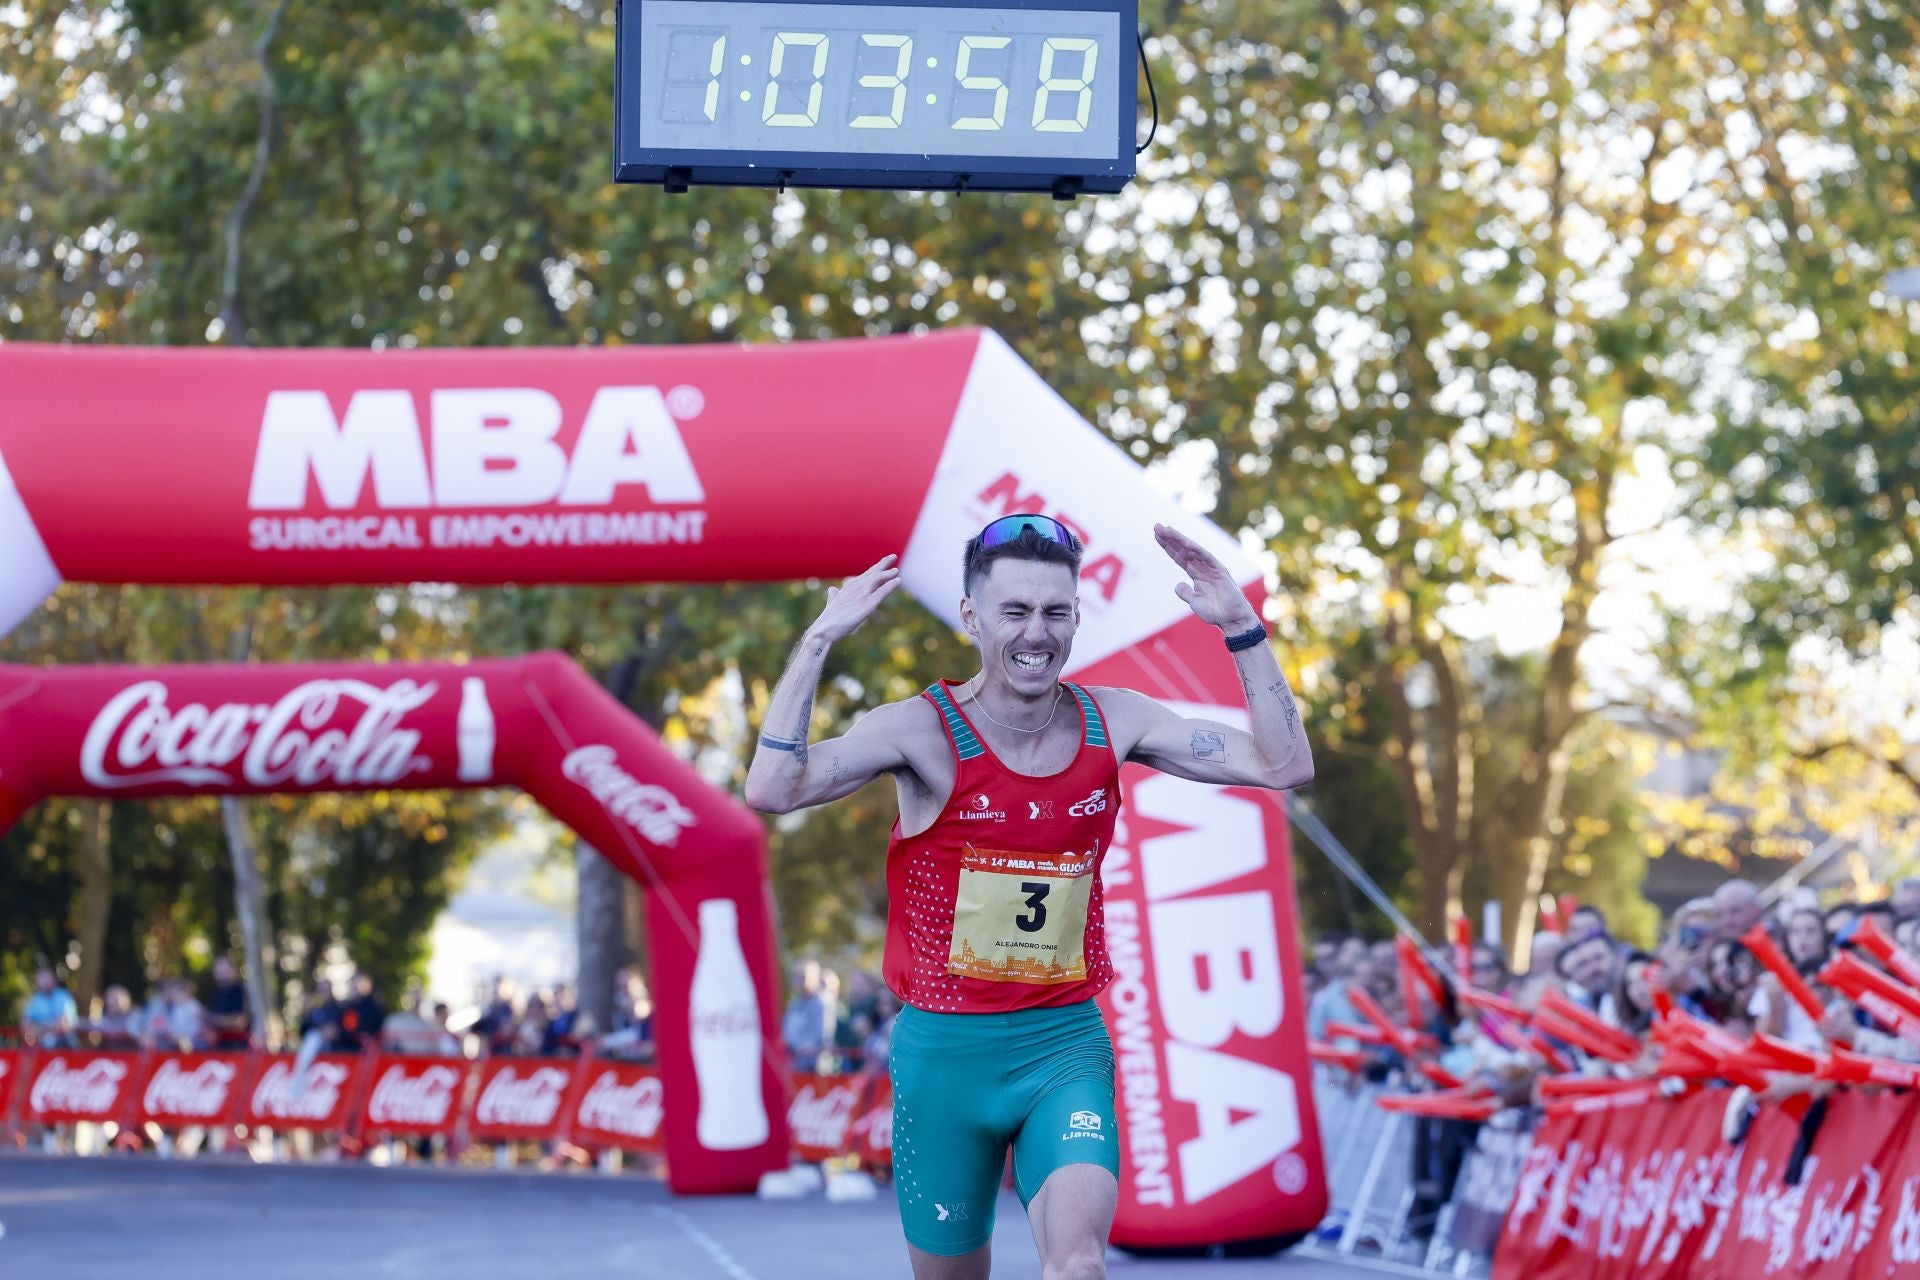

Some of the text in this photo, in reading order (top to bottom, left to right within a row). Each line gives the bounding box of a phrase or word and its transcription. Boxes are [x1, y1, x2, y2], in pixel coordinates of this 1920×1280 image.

[703, 32, 1100, 133] 1:03:58
[247, 384, 706, 510] MBA
[248, 511, 707, 549] SURGICAL EMPOWERMENT
[959, 809, 1006, 820] Llamieva
[1007, 859, 1035, 870] MBA
[1015, 881, 1051, 933] 3
[995, 940, 1058, 951] ALEJANDRO ONIS
[1104, 899, 1175, 1208] EMPOWERMENT
